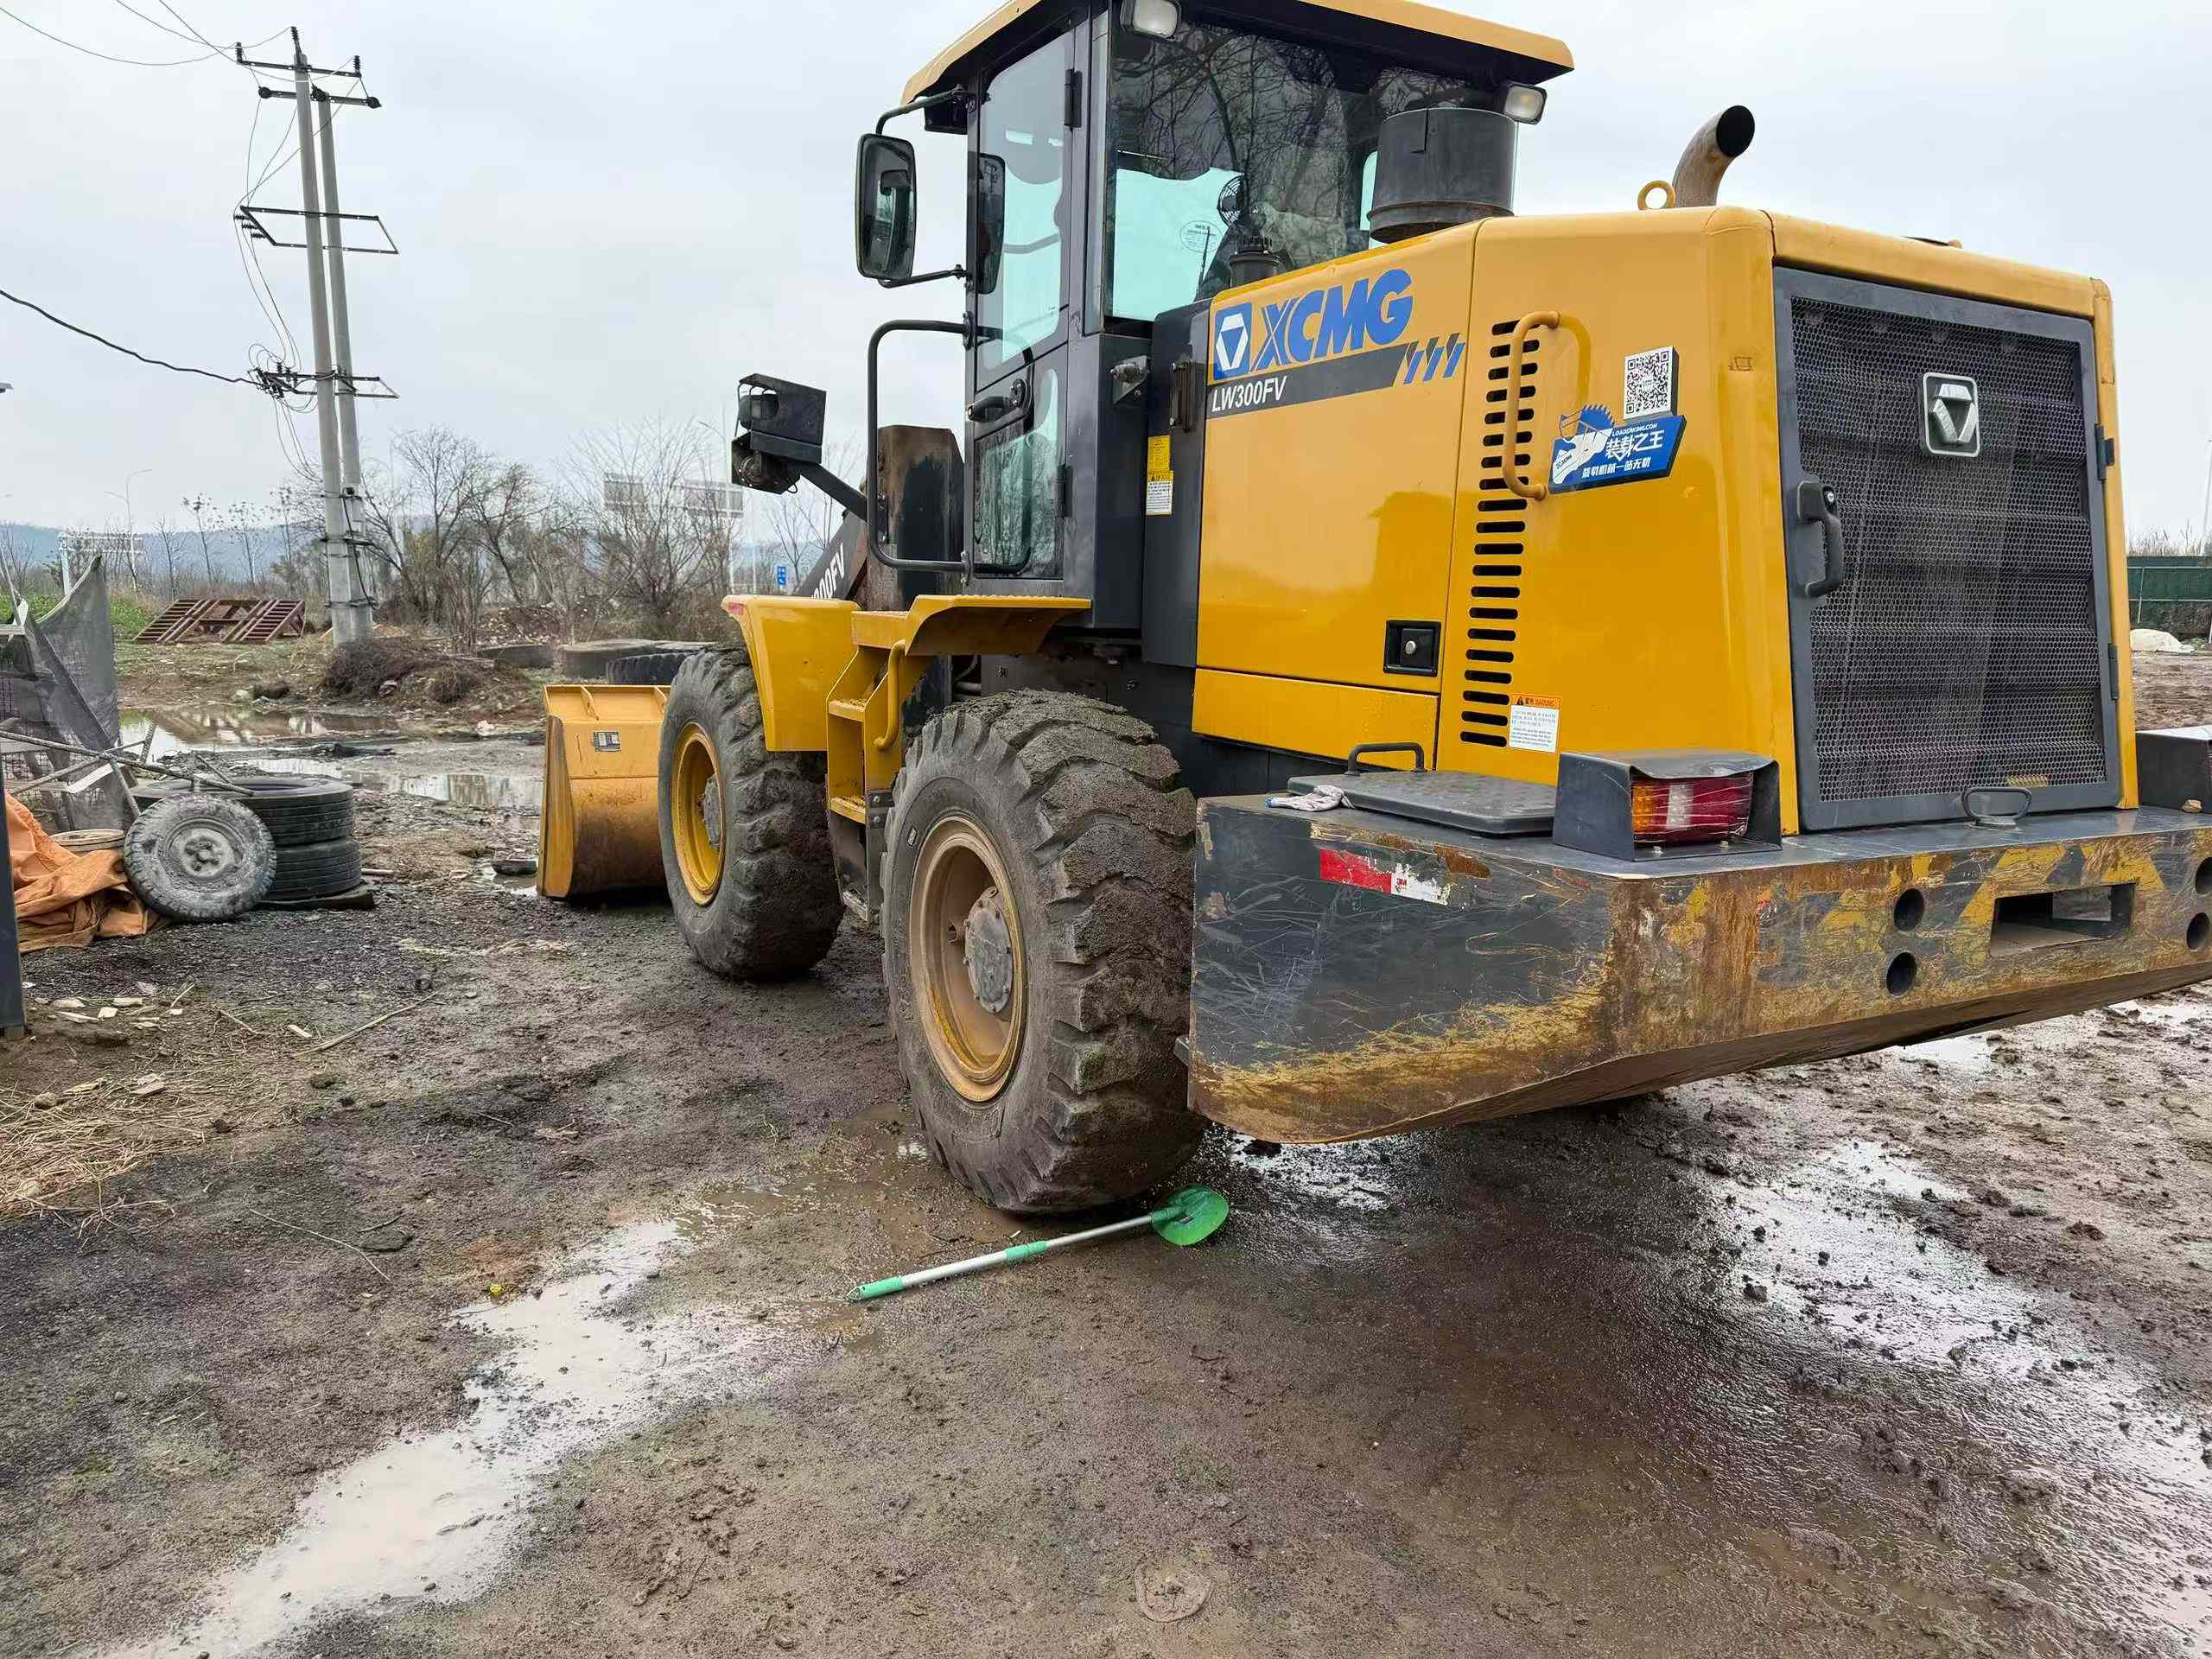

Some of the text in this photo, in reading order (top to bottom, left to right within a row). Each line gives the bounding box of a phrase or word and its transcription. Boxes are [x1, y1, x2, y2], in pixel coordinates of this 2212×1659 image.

[1253, 269, 1414, 373] XCMG
[1211, 375, 1287, 413] LW300FV
[1605, 429, 1665, 461] 装载之王
